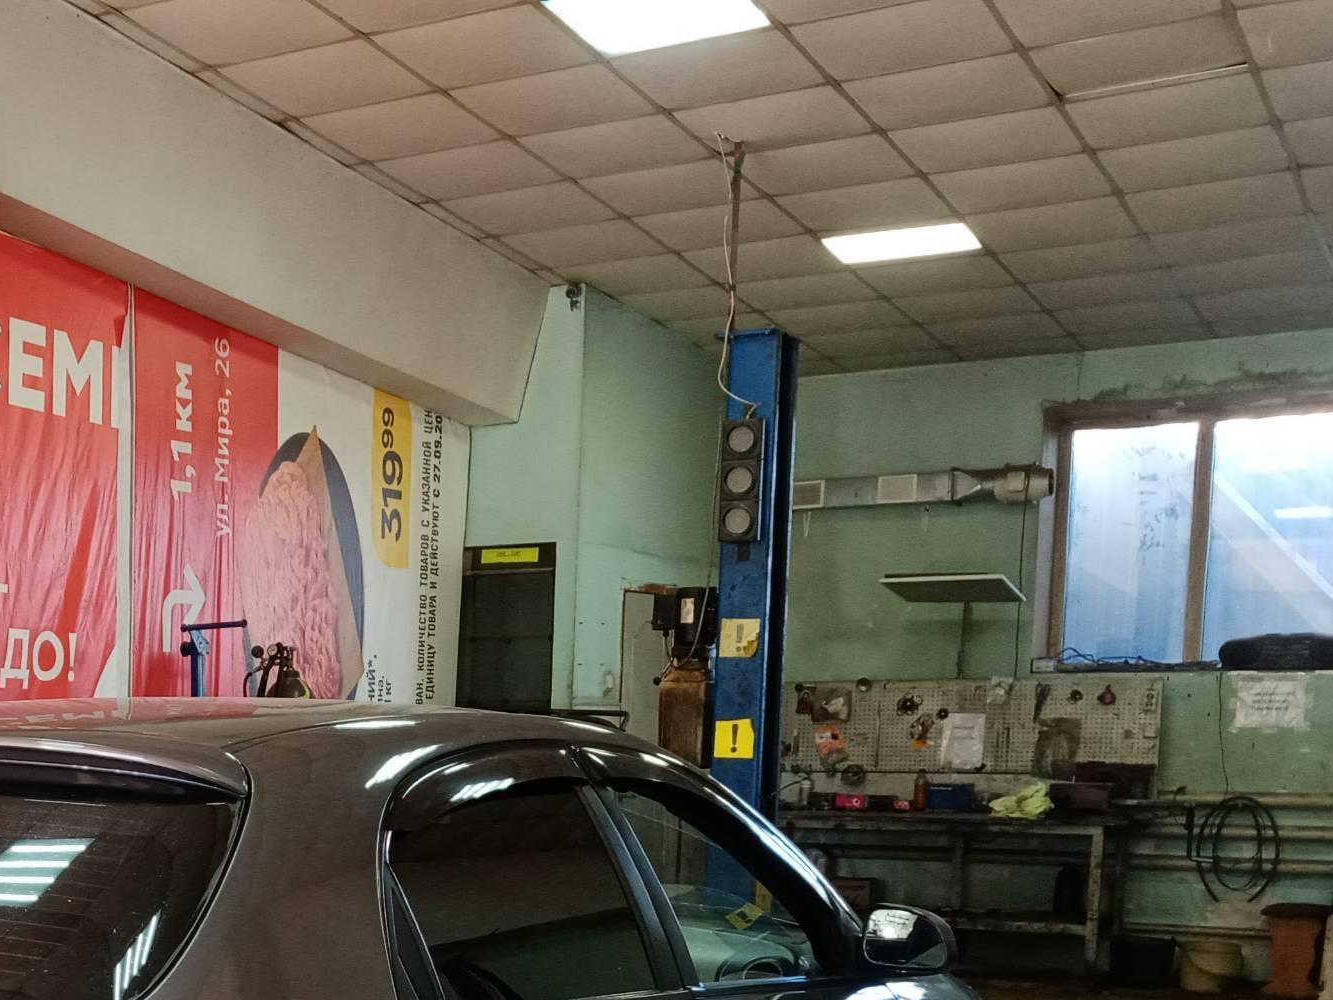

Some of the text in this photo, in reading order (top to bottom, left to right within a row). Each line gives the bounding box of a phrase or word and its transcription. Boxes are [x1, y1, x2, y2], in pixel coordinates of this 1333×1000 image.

[215, 337, 230, 378] 26
[214, 388, 234, 483] Мира,
[423, 409, 434, 434] ЦЕН
[433, 413, 443, 484] 27.09.20
[170, 439, 196, 501] 1,1
[421, 440, 432, 512] УКАЗАННОЙ
[419, 534, 430, 587] ТОВАРОВ
[430, 503, 440, 577] ДЕЙСТВУЮТ
[417, 594, 427, 671] КОЛИЧЕСТВО
[427, 595, 437, 638] ТОВАРА
[425, 644, 436, 700] ЕДИНИЦУ
